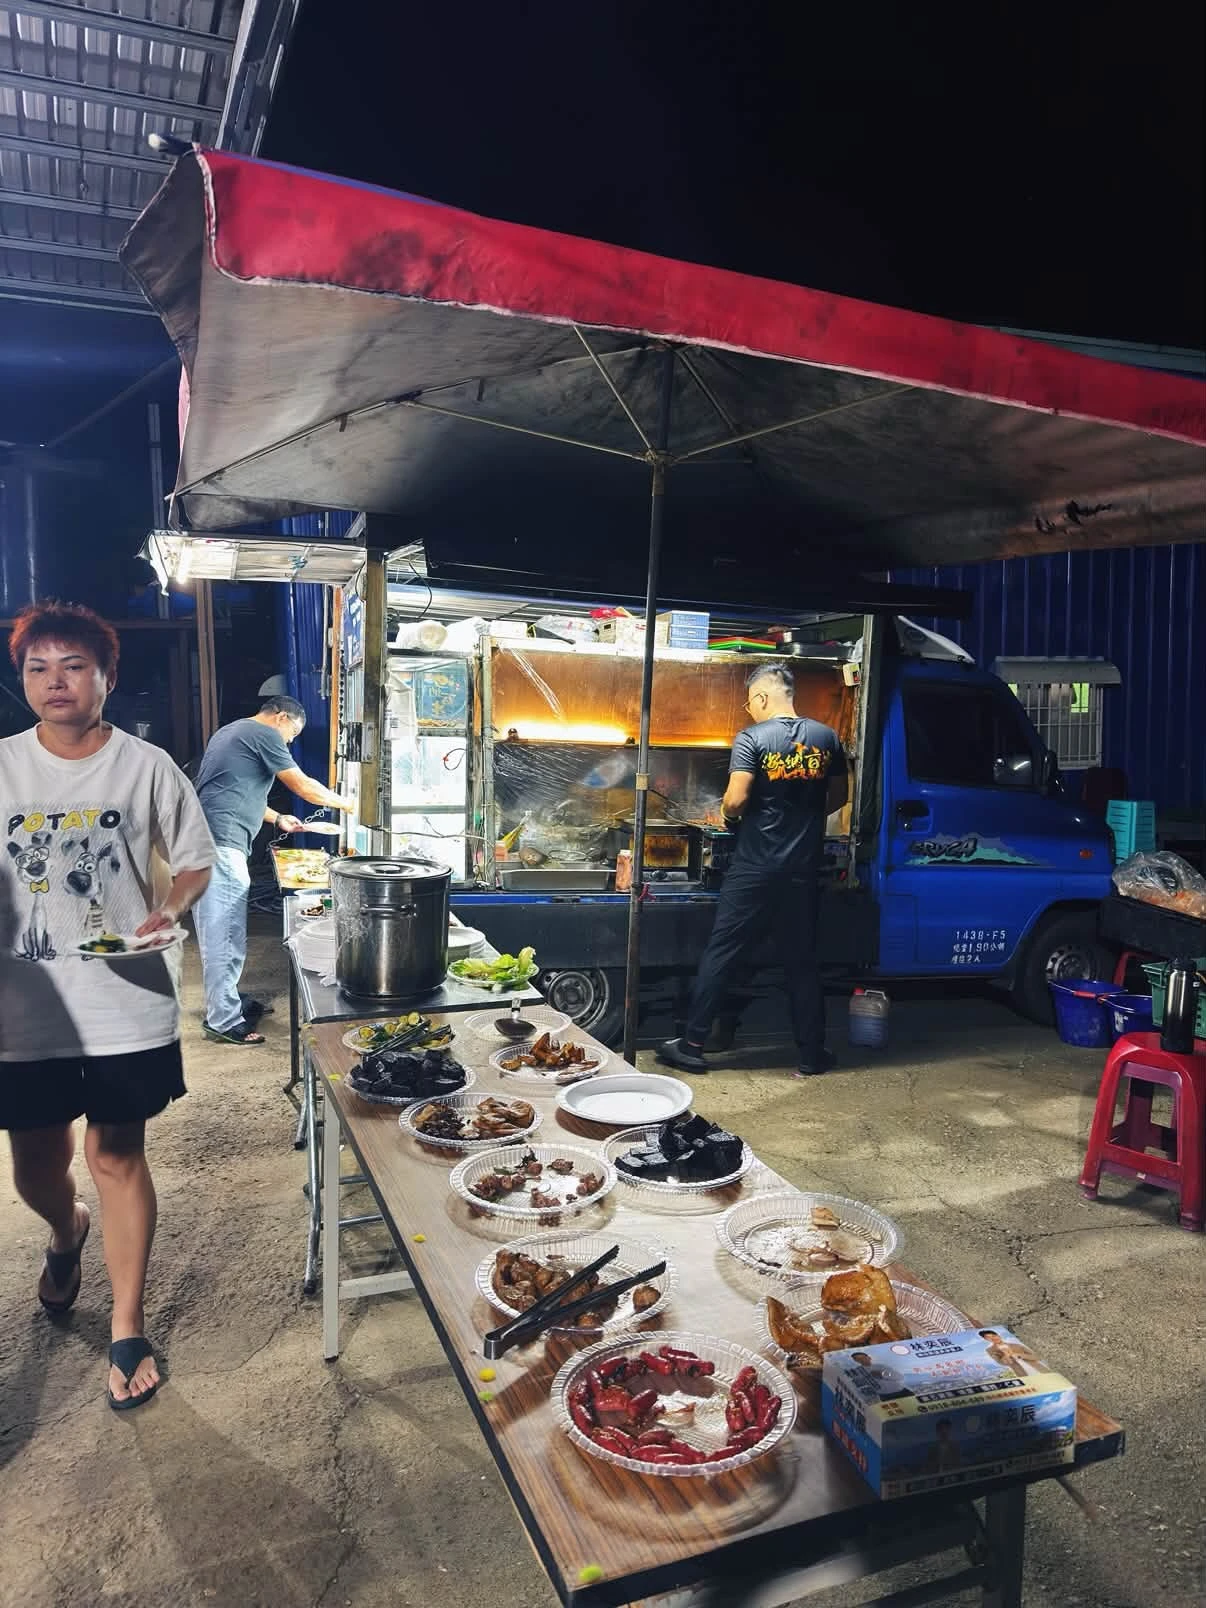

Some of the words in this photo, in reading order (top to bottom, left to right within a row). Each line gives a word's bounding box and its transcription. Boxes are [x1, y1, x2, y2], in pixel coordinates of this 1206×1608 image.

[7, 809, 121, 836] POTATO
[956, 930, 1006, 940] 1438-F5
[910, 1338, 954, 1351] 林奕辰
